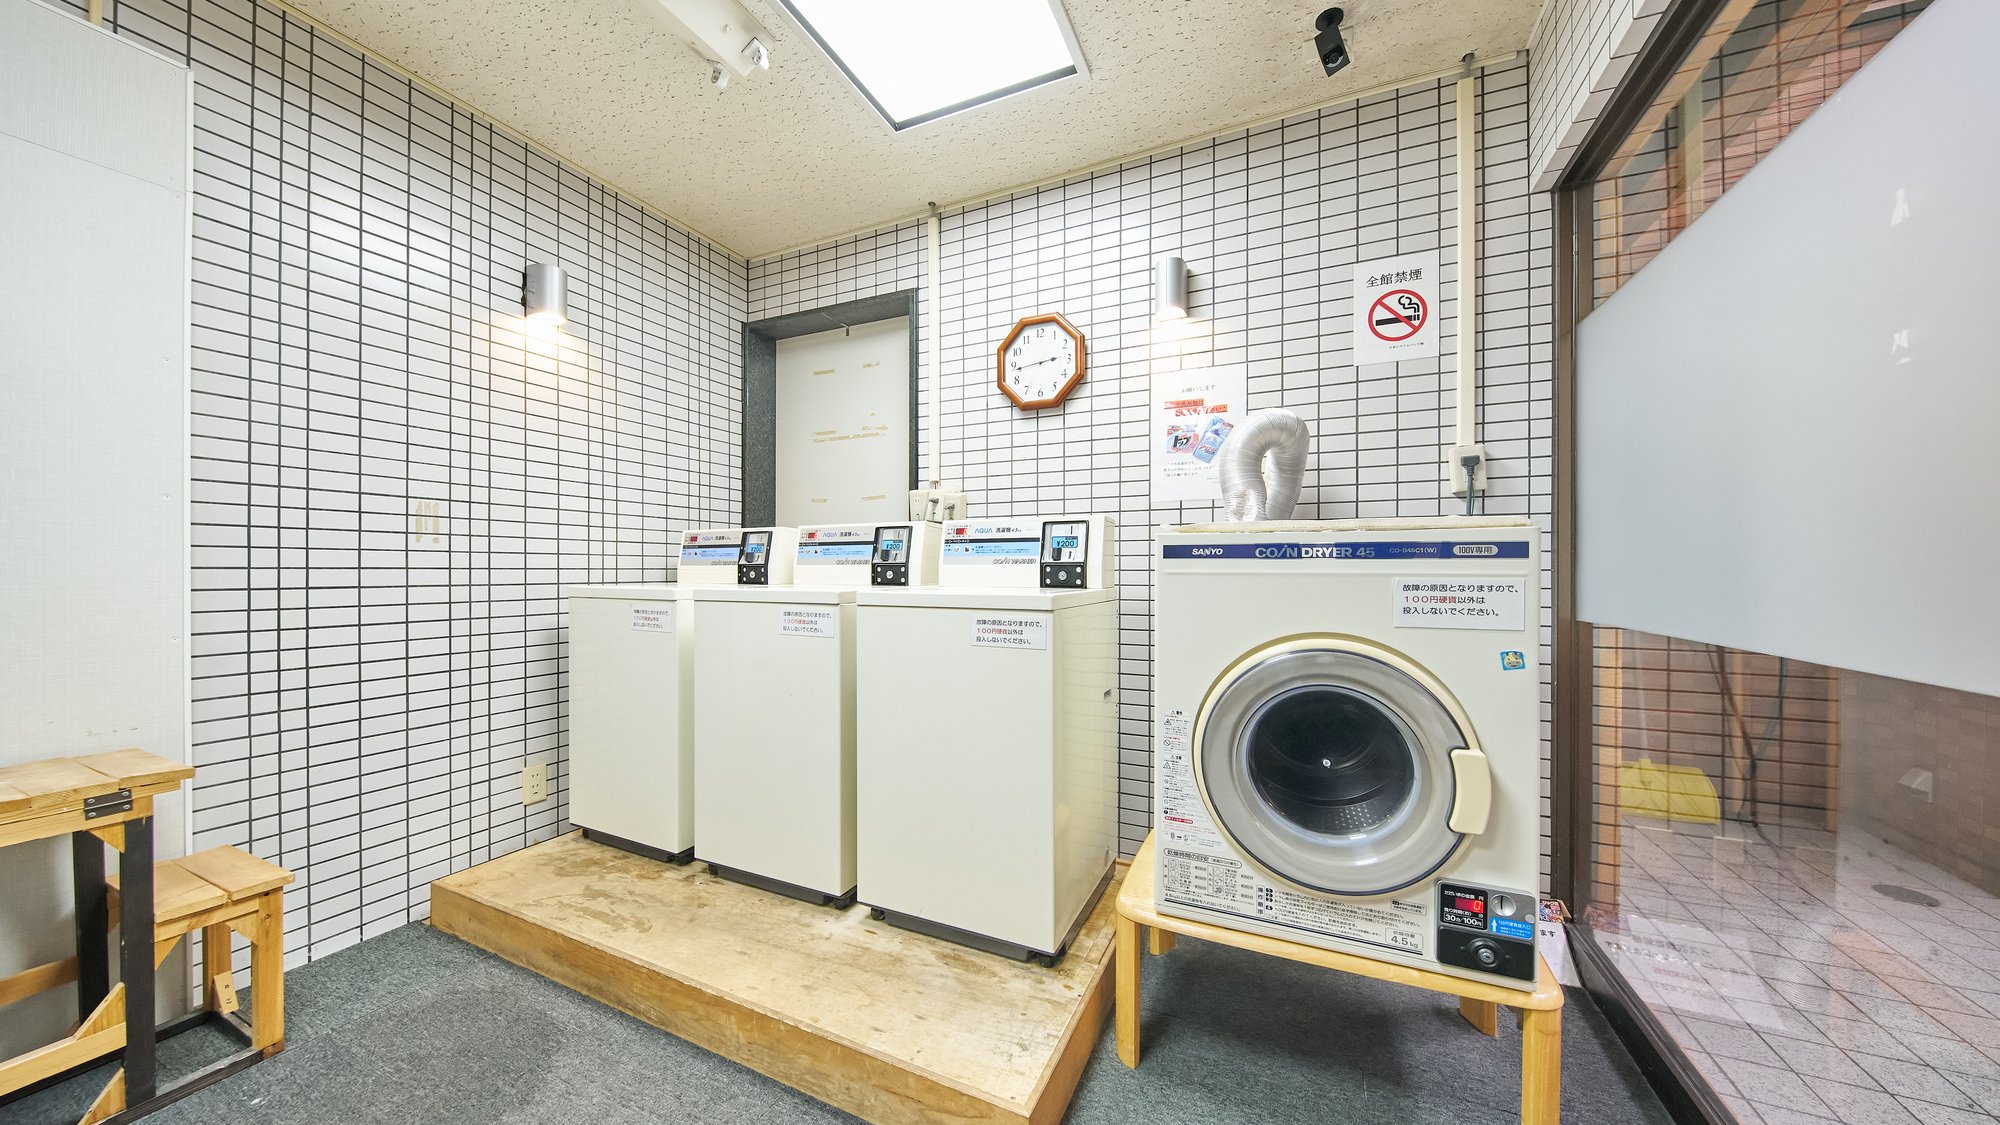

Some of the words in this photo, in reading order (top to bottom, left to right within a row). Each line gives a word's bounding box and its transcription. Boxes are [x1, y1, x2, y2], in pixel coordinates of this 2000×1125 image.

[1366, 268, 1422, 288] 全館禁煙
[1036, 328, 1045, 338] 12
[1023, 336, 1030, 344] 11
[1062, 339, 1068, 349] 2
[1013, 347, 1022, 357] 10
[1067, 354, 1072, 364] 3
[1011, 361, 1016, 371] 9
[1061, 369, 1068, 378] 4
[1014, 375, 1020, 385] 8
[1024, 386, 1029, 396] 7
[1052, 382, 1057, 392] 5
[1038, 388, 1044, 397] 6
[1173, 435, 1192, 448] トップ
[1192, 548, 1223, 556] SANYO
[1301, 547, 1352, 558] DRYER
[1356, 547, 1375, 558] 45
[1458, 546, 1493, 554] 100V専用
[1402, 584, 1519, 593] 故障の原因となりますので、
[1402, 606, 1499, 616] 投入しないでください。
[976, 619, 1042, 627] 故障の原因となりますので、
[976, 636, 1031, 644] 投入しないでください。
[1474, 900, 1481, 910] 0
[1391, 936, 1408, 946] 4.5
